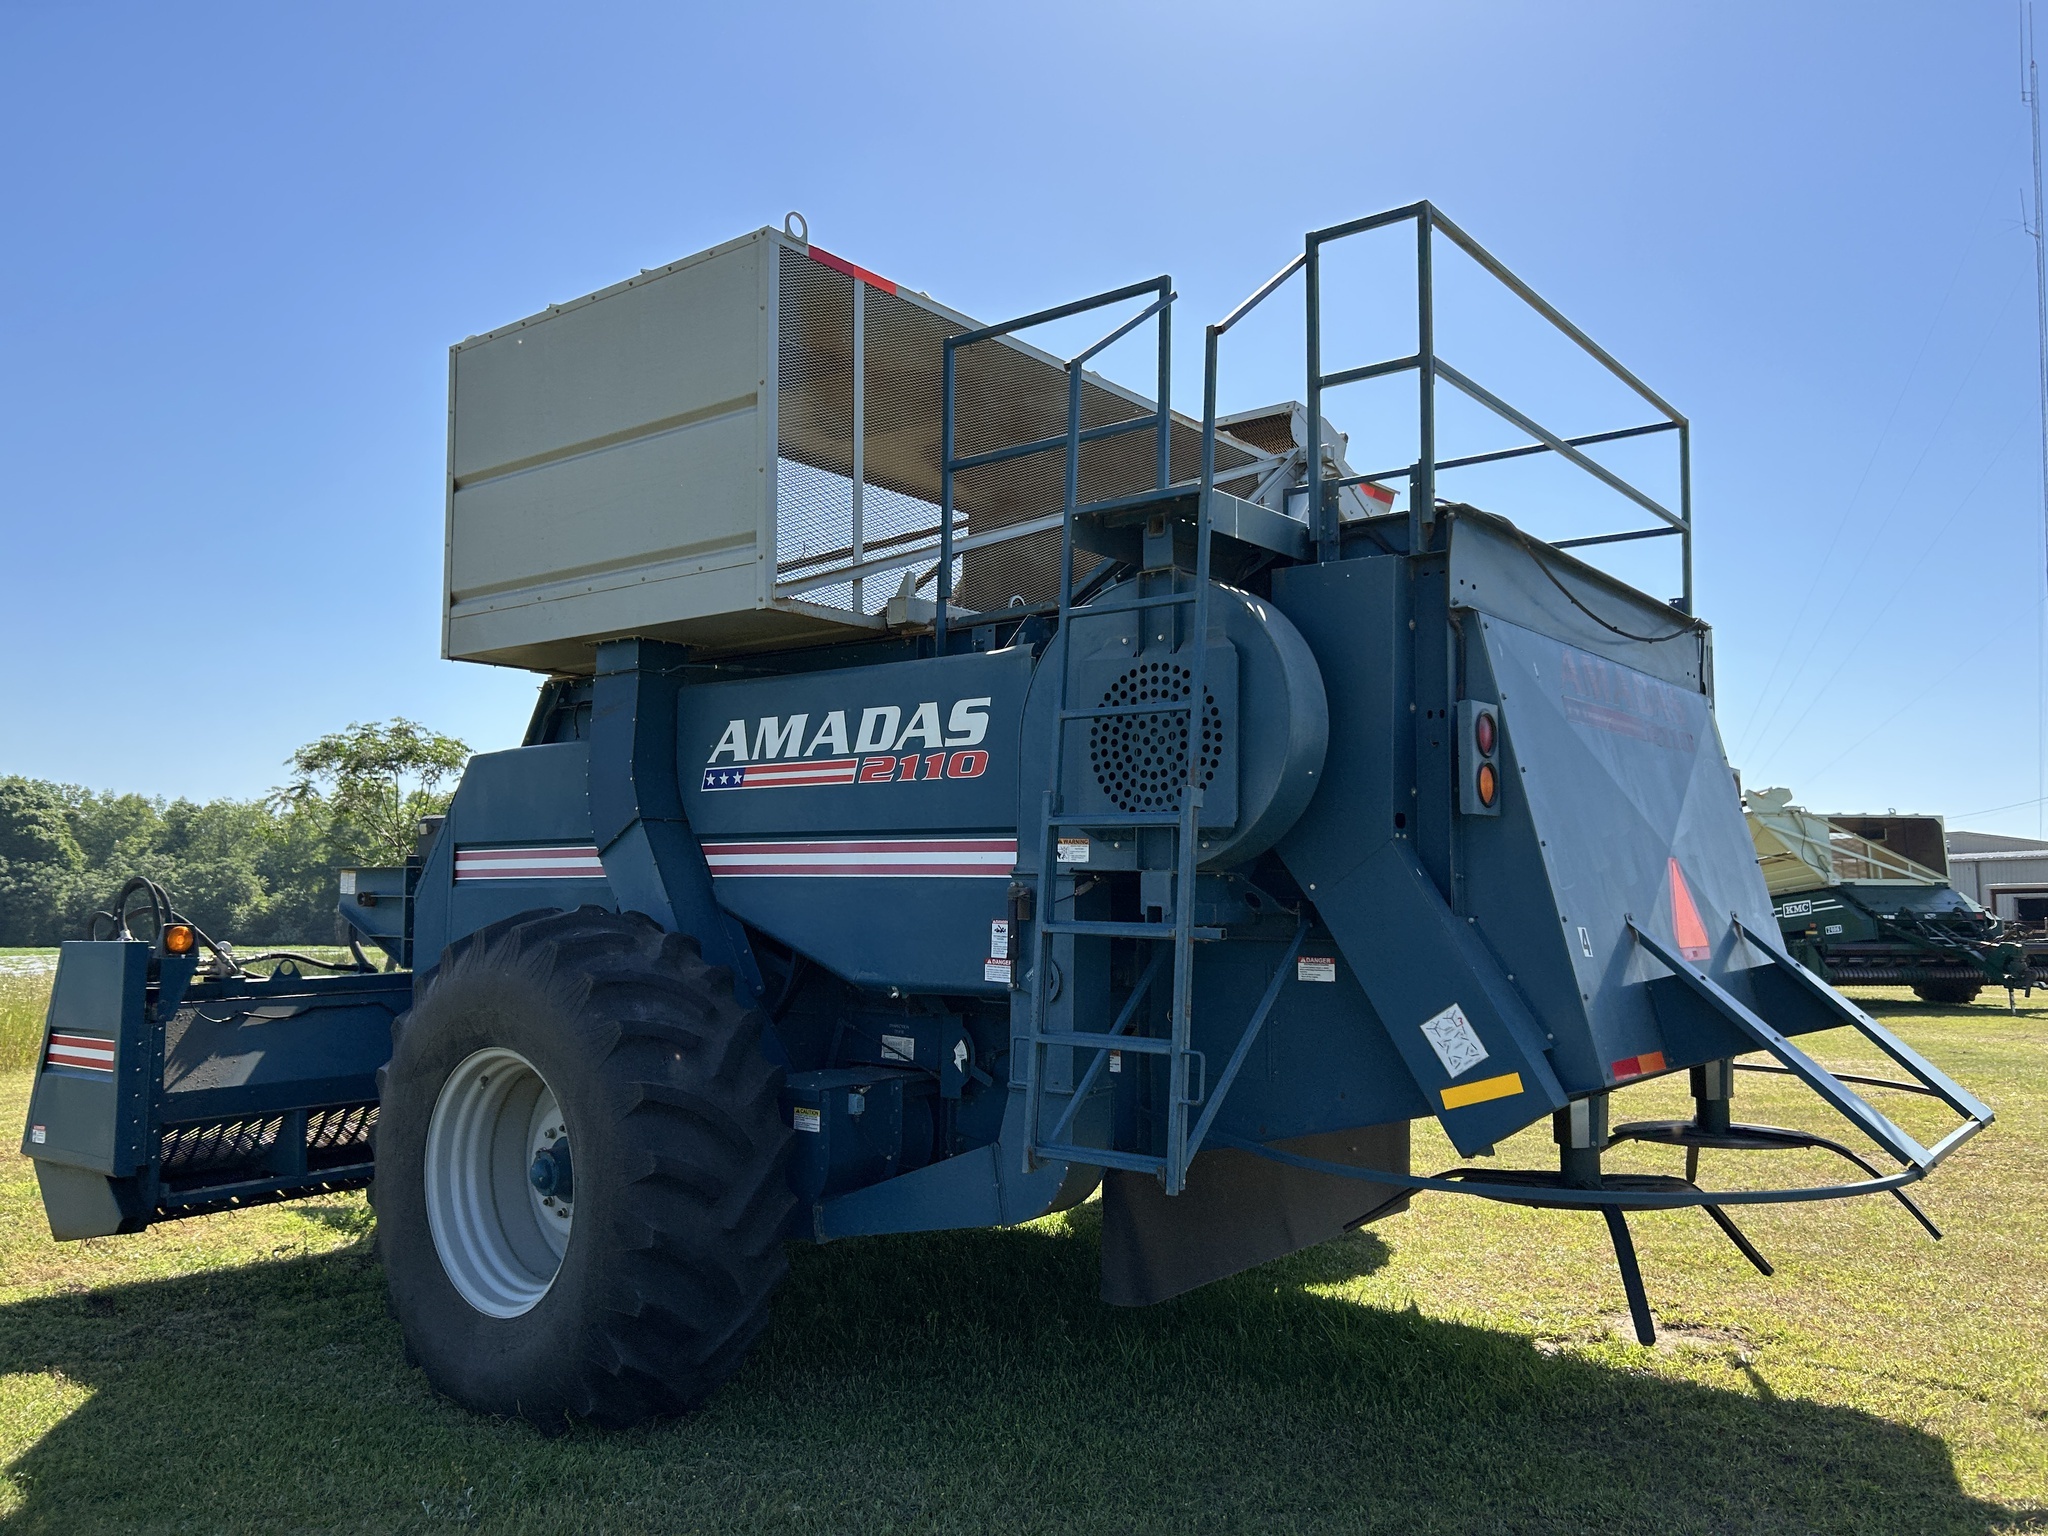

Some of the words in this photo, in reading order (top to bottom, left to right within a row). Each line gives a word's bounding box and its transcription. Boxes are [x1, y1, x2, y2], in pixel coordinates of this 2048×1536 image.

[707, 697, 991, 763] AMADAS
[858, 750, 989, 784] 2110
[1785, 903, 1809, 914] KMC
[1582, 928, 1591, 956] 4
